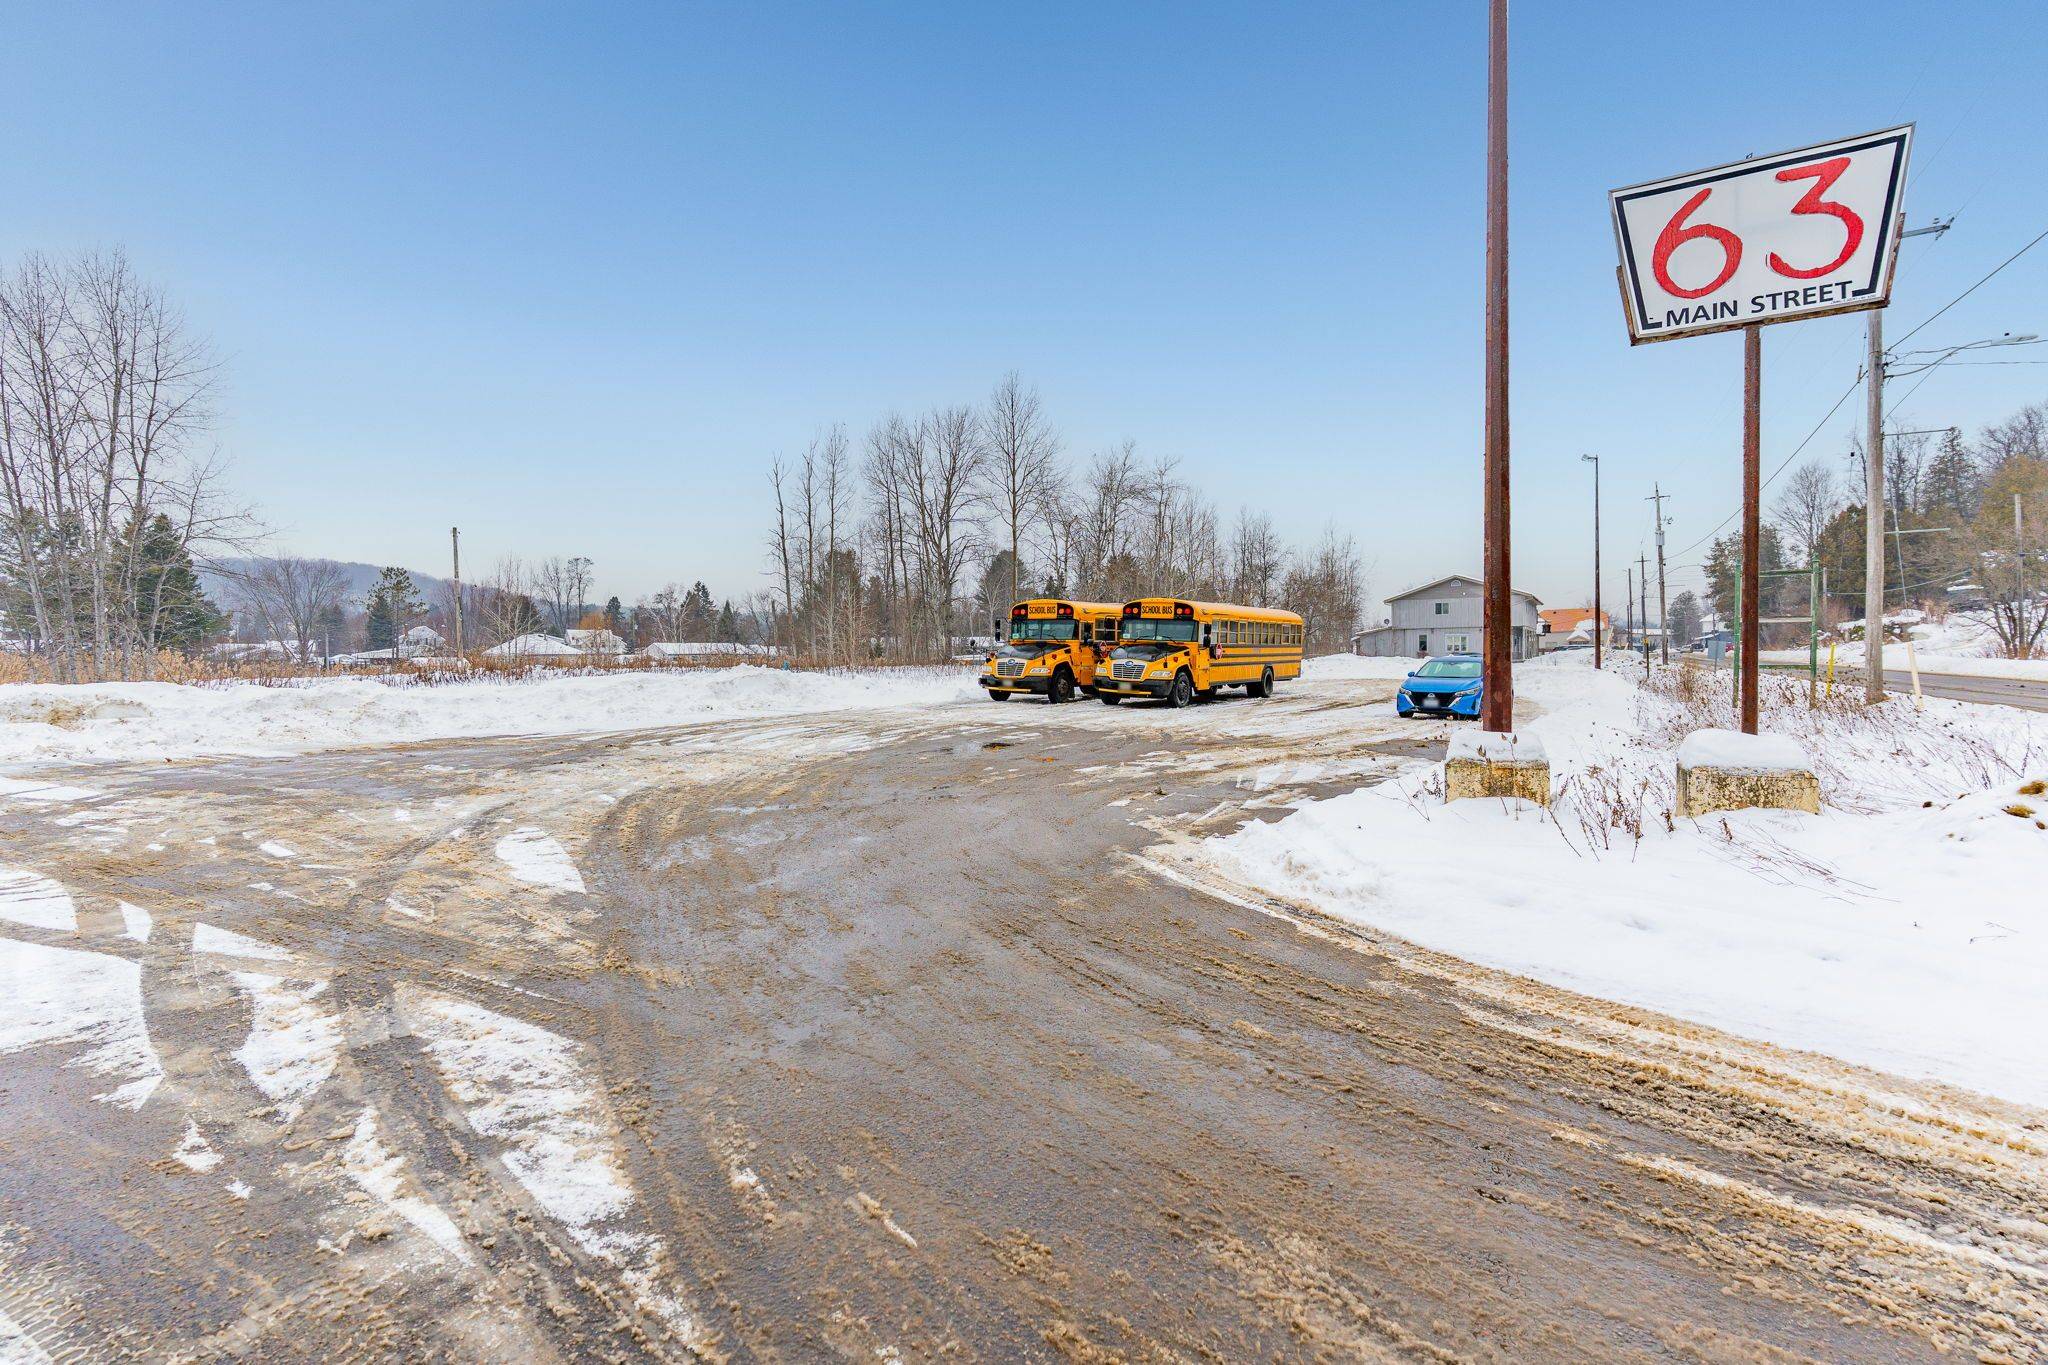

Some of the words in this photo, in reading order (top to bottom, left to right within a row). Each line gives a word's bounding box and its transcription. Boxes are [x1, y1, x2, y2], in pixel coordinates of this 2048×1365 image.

[1653, 157, 1864, 299] 63
[1666, 300, 1738, 327] MAIN
[1751, 280, 1852, 314] STREET
[1029, 606, 1046, 614] SCHOOL
[1047, 606, 1056, 614] BUS
[1142, 605, 1161, 614] SCHOOL
[1162, 606, 1173, 614] BUS
